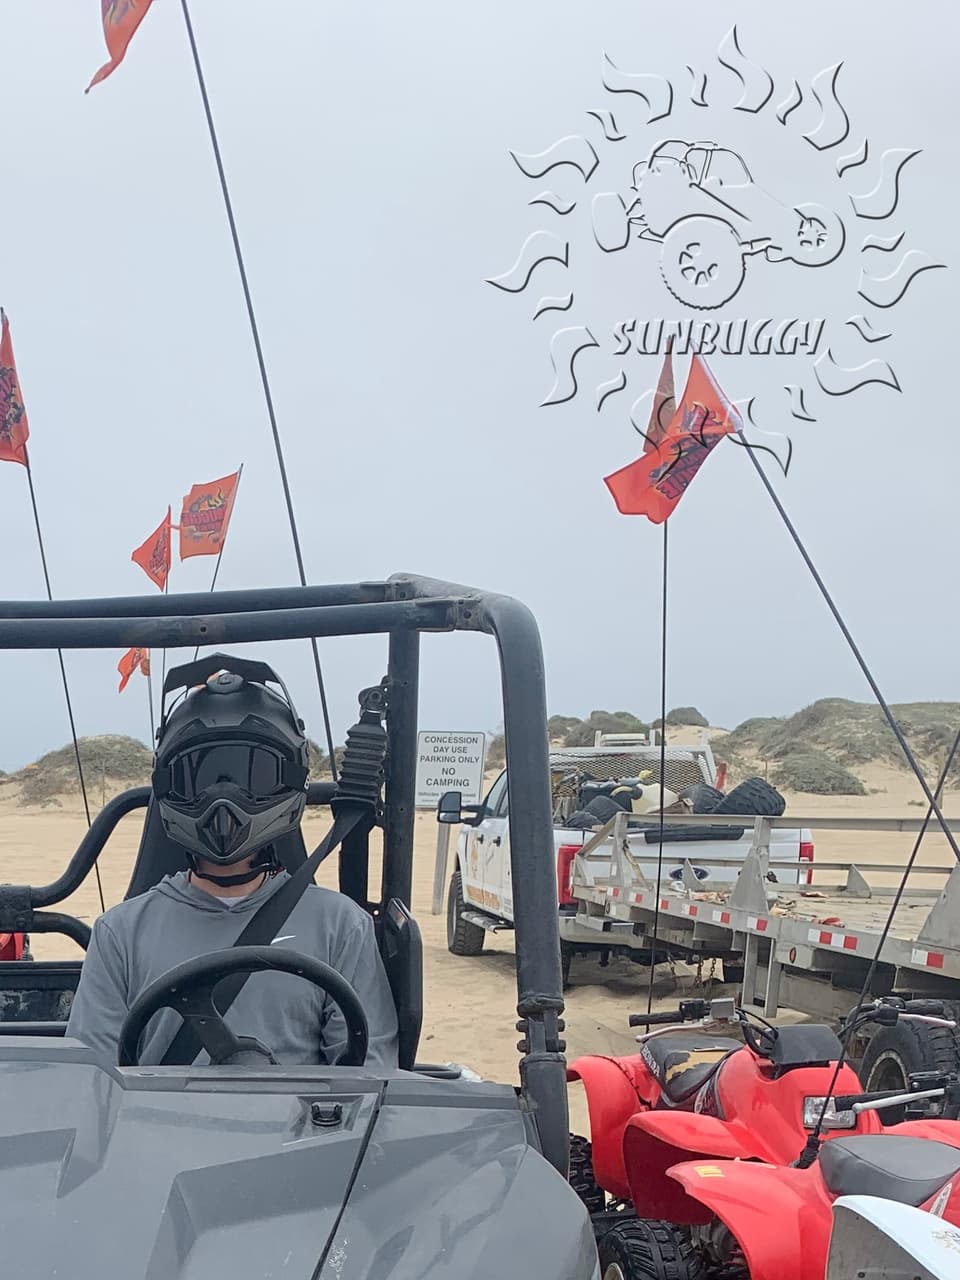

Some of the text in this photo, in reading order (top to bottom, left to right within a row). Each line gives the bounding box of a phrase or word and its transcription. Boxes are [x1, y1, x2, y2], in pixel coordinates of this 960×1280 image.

[424, 736, 478, 744] CONCESSION
[420, 755, 456, 763] PARKING
[441, 767, 456, 775] NO
[426, 778, 470, 787] CAMPING
